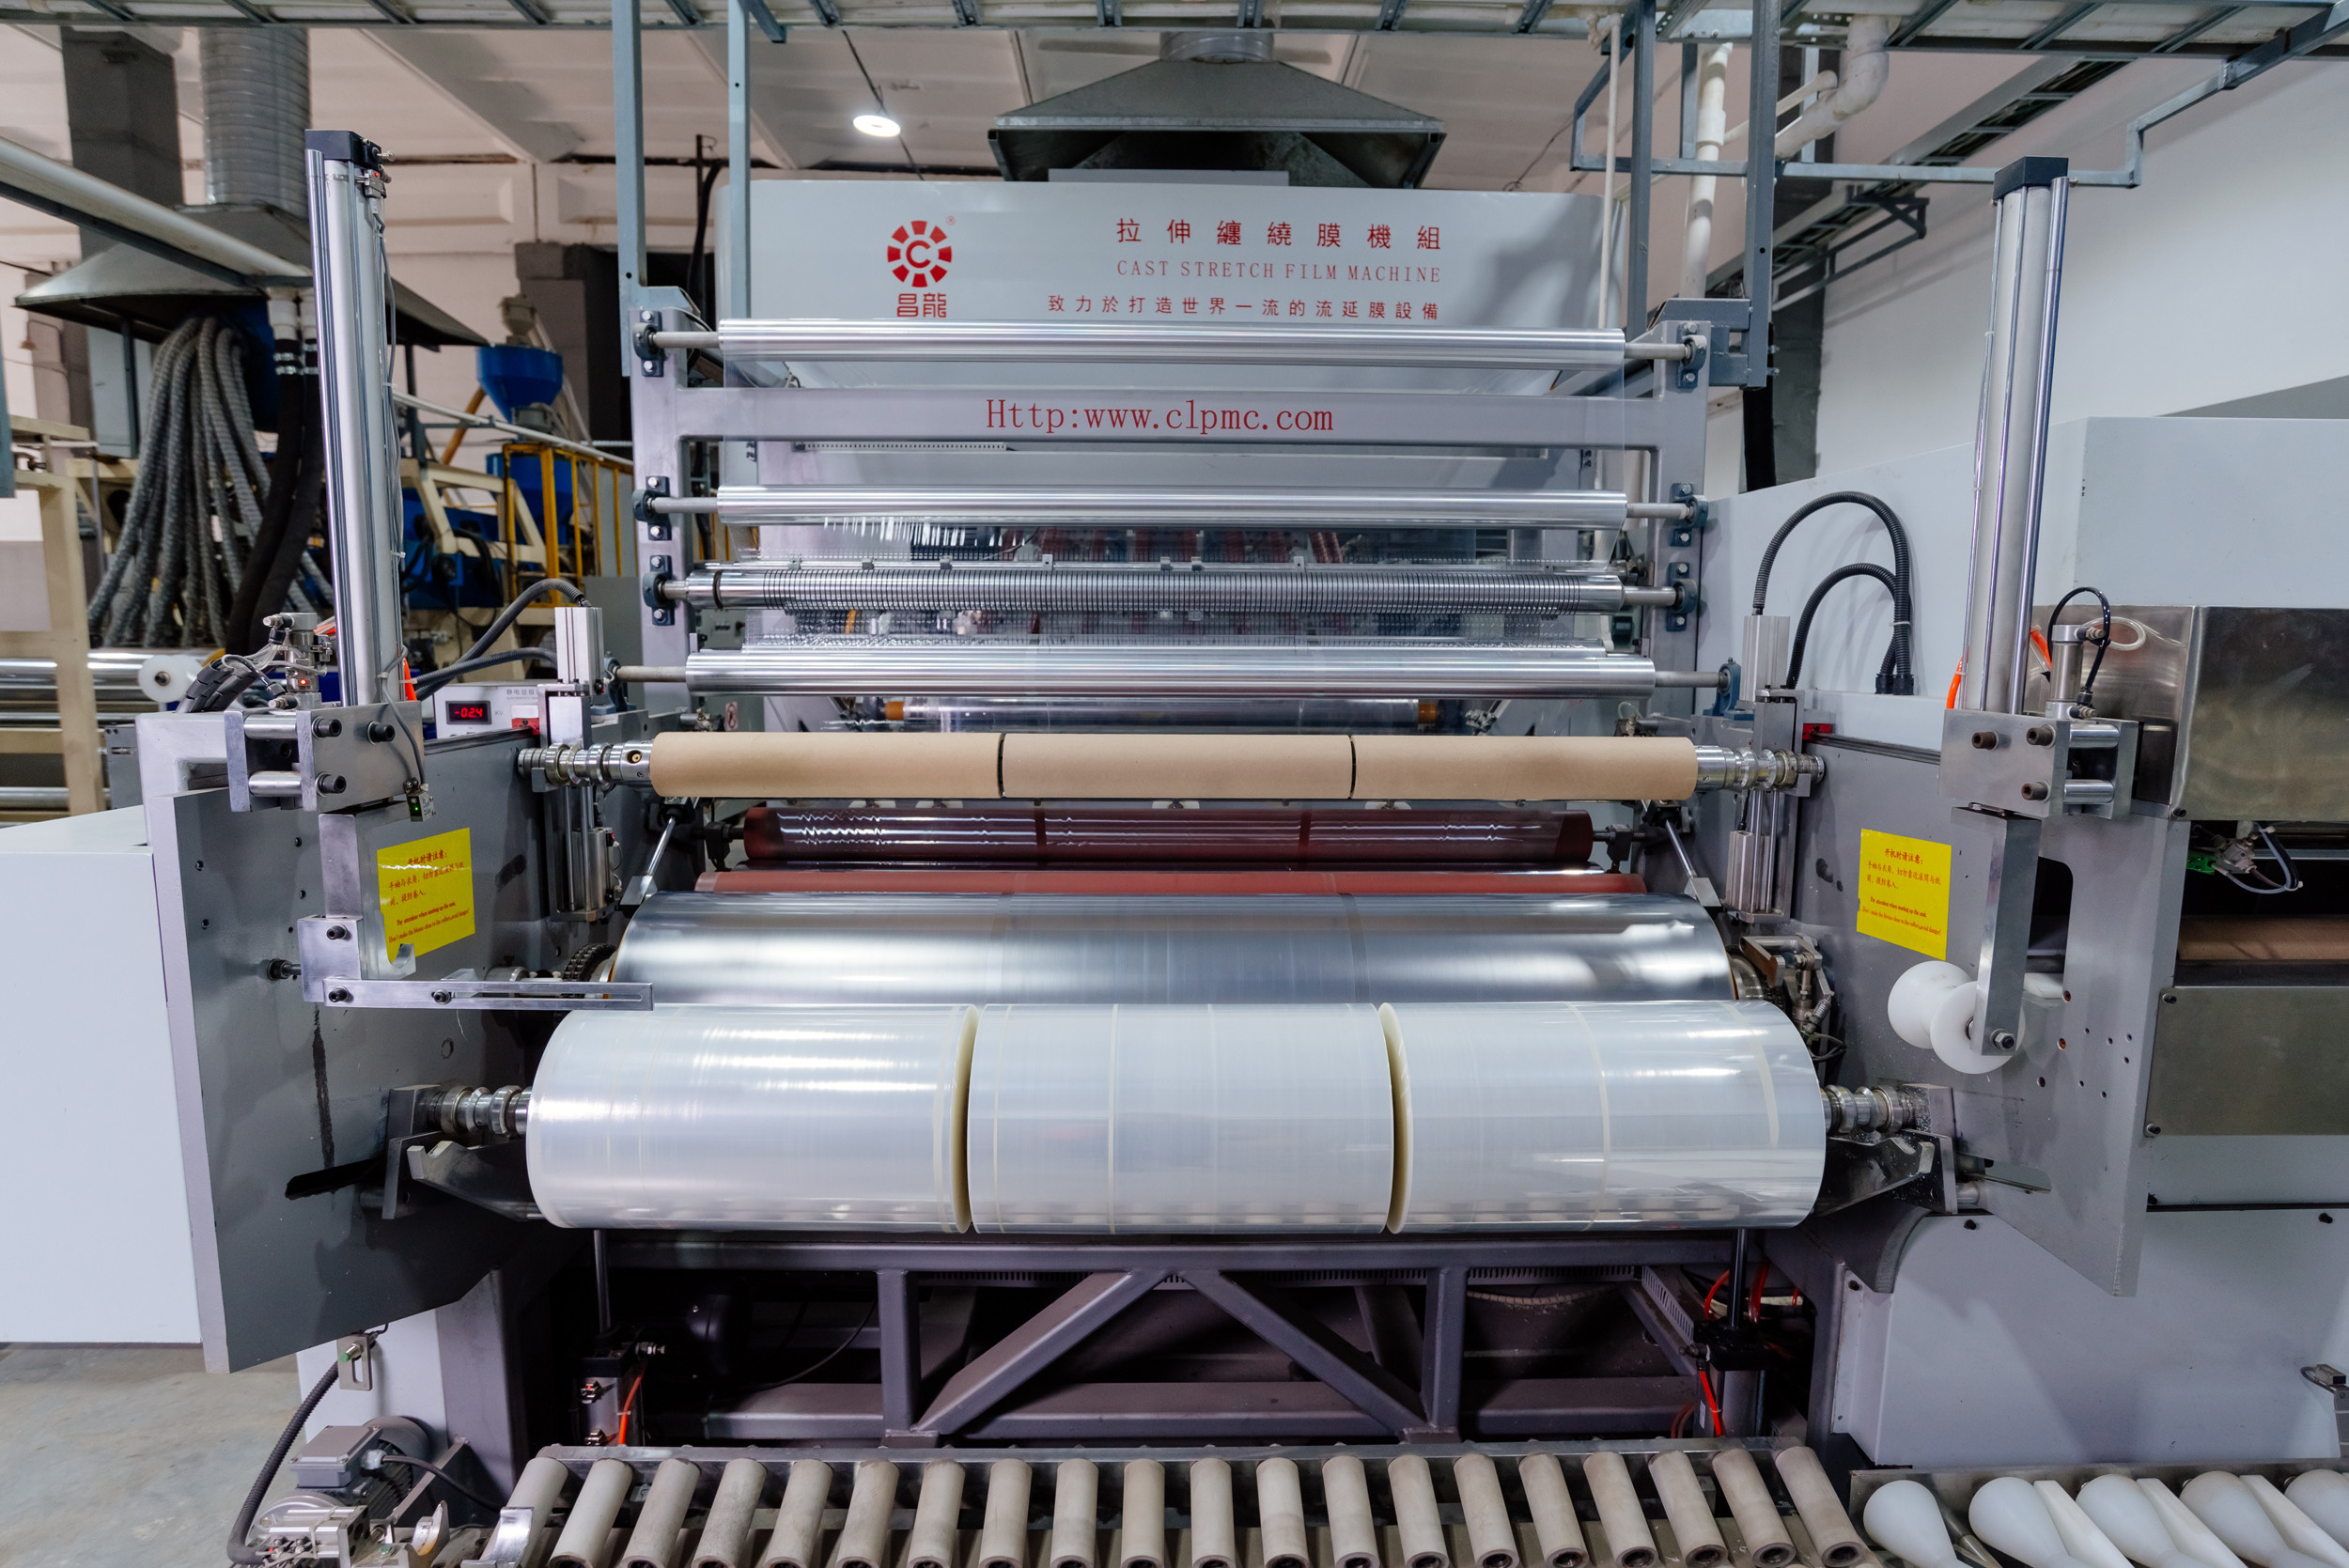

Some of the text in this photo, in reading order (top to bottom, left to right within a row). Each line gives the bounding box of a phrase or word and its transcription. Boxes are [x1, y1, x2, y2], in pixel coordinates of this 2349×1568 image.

[1116, 218, 1441, 250] 拉伸纏繞膜機組
[1117, 260, 1441, 283] CAST STRETCH FILM MACHINE
[897, 293, 947, 318] 昌龍
[1049, 295, 1439, 319] 致力於打造世界一流的流延膜設備
[987, 399, 1333, 434] Http:www.clpmc.com
